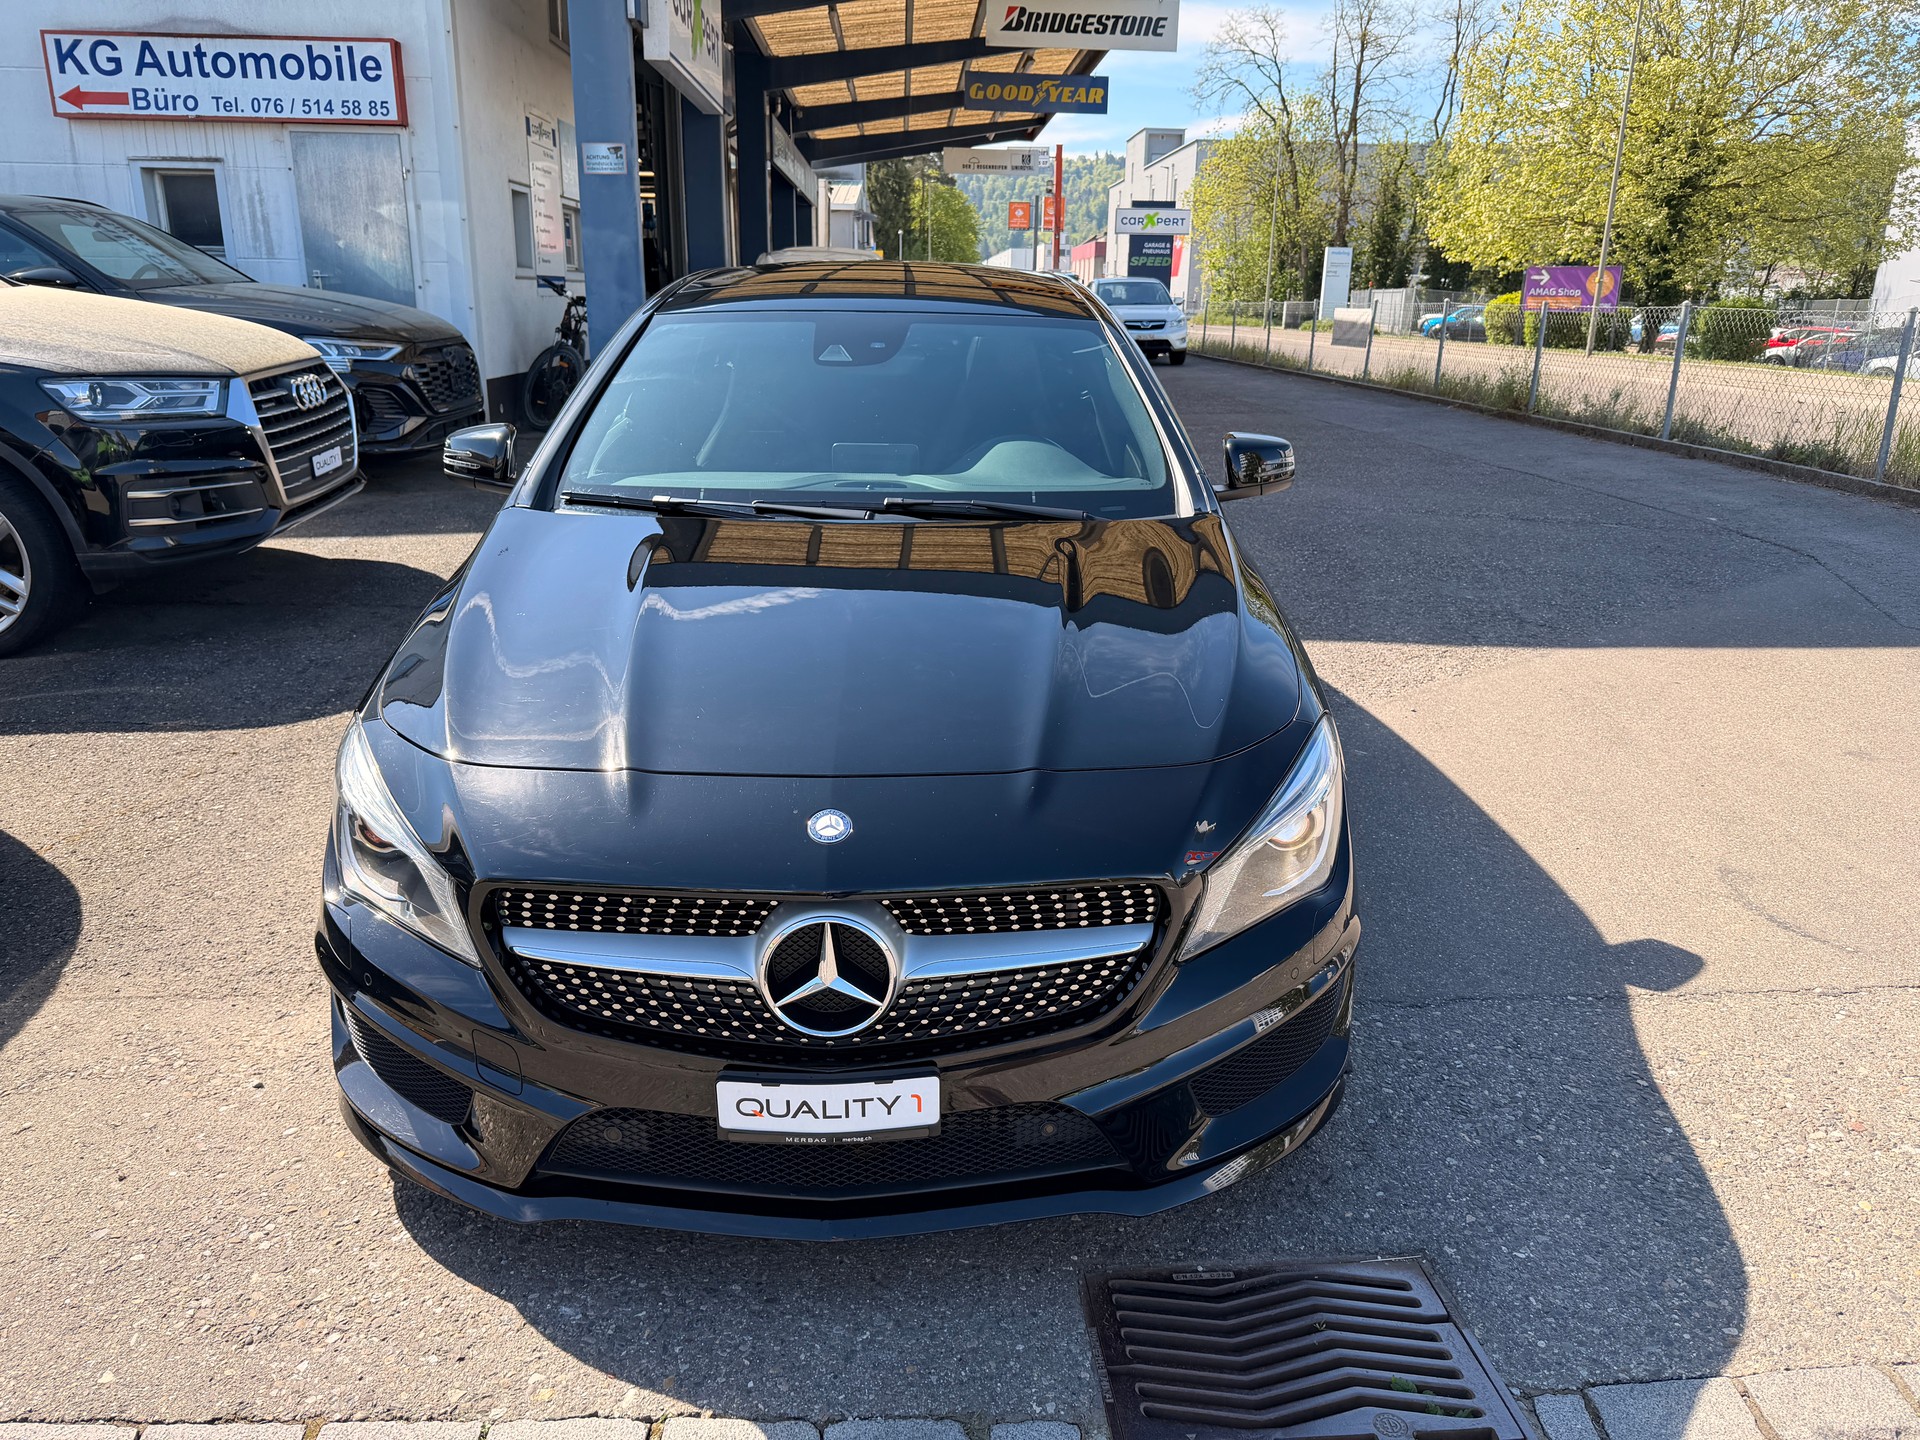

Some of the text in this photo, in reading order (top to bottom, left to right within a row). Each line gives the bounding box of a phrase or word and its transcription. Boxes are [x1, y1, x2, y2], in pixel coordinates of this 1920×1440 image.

[1001, 6, 1168, 37] BRIDGESTONE
[53, 38, 383, 82] KG Automobile
[132, 87, 199, 112] Büro
[211, 96, 245, 113] Tel.
[251, 97, 284, 115] 076
[302, 98, 334, 116] 514
[341, 99, 362, 116] 58
[368, 100, 390, 117] 85
[1129, 256, 1171, 267] SPEED
[1528, 287, 1581, 297] AMAG Shop
[315, 454, 336, 470] QUALITY
[735, 1093, 922, 1120] QUALITY 1
[785, 1136, 873, 1144] MERBAG merbag.ch
